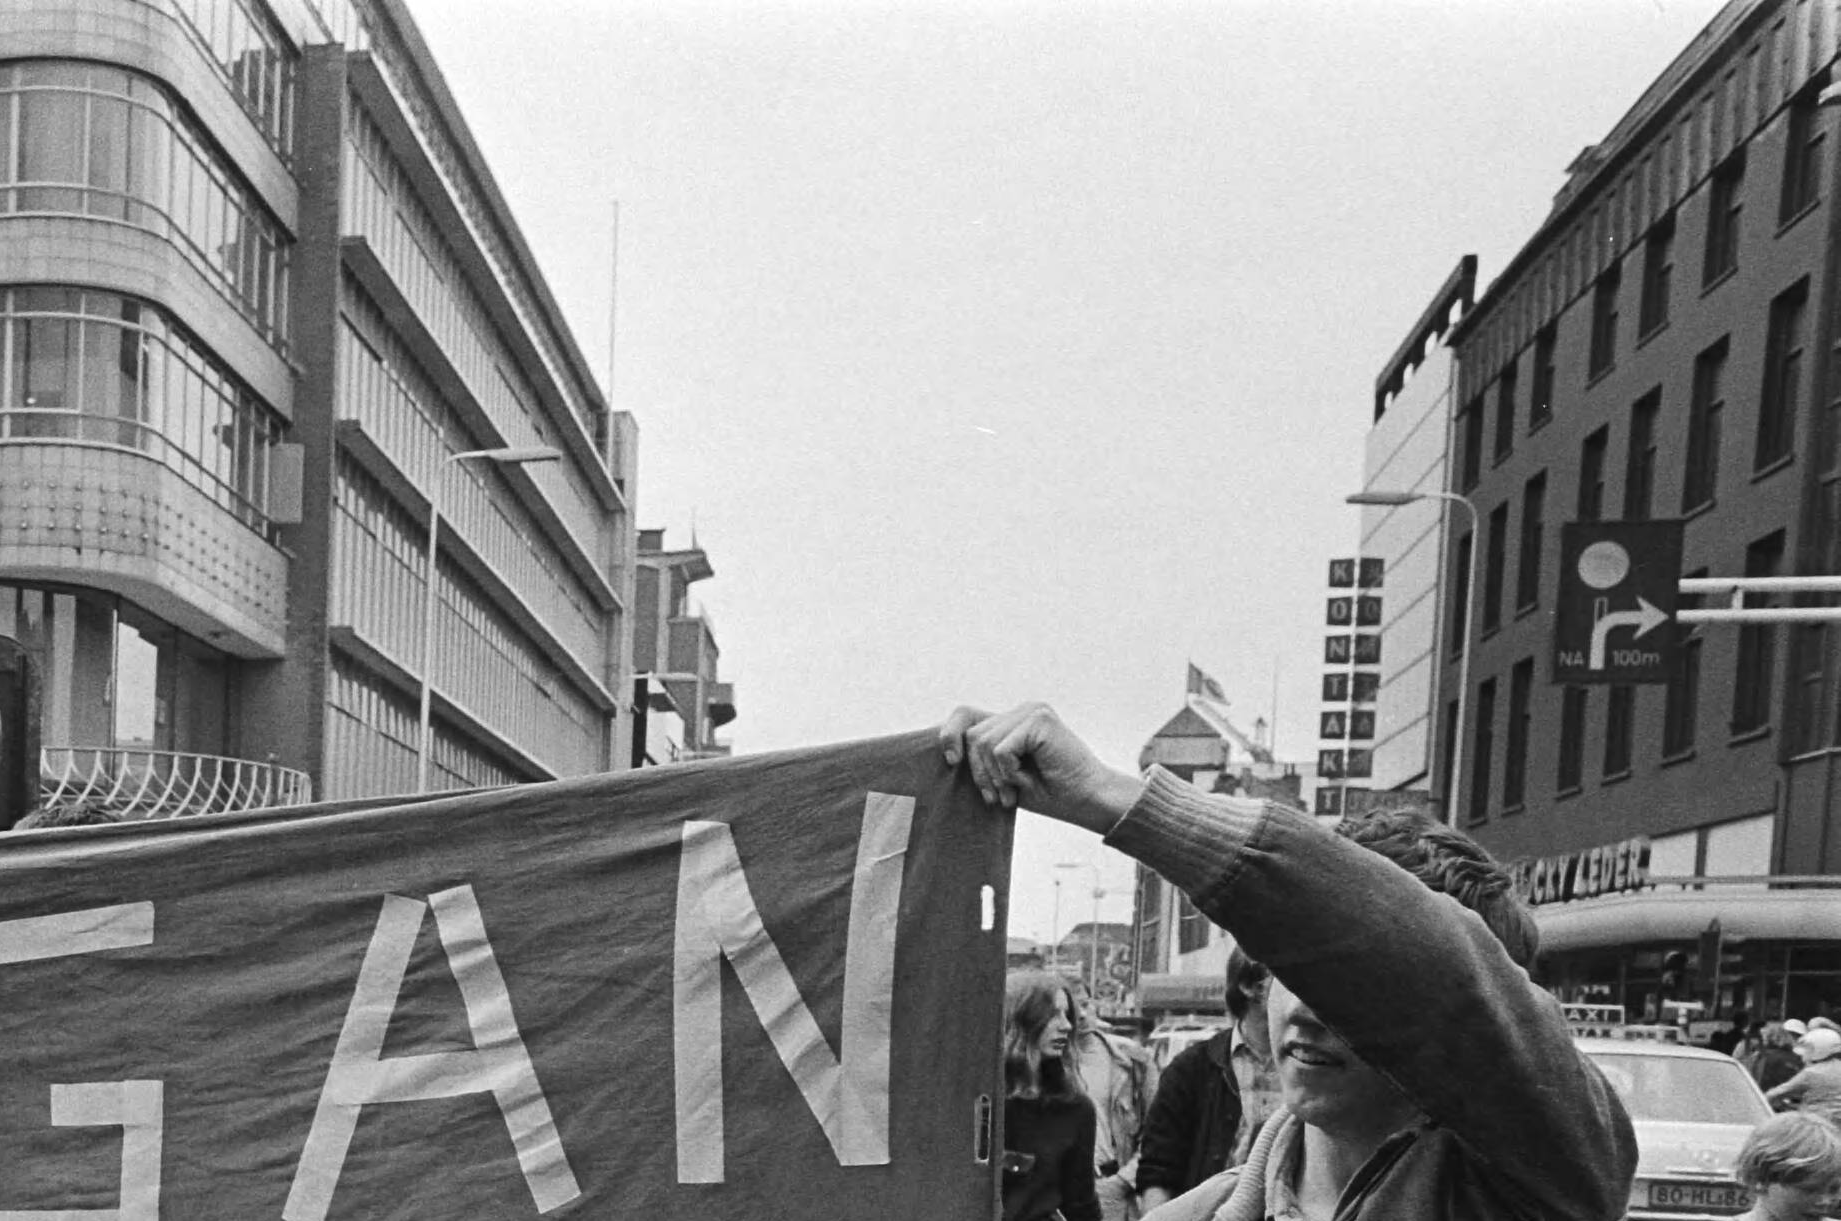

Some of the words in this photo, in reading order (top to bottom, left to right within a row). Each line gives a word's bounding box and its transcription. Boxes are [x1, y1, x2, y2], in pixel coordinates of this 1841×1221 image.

[1558, 650, 1584, 667] NA
[1612, 649, 1661, 667] 100m
[1320, 561, 1350, 812] KONTAKT
[1572, 838, 1644, 896] LEDER
[1565, 1008, 1609, 1021] AXI
